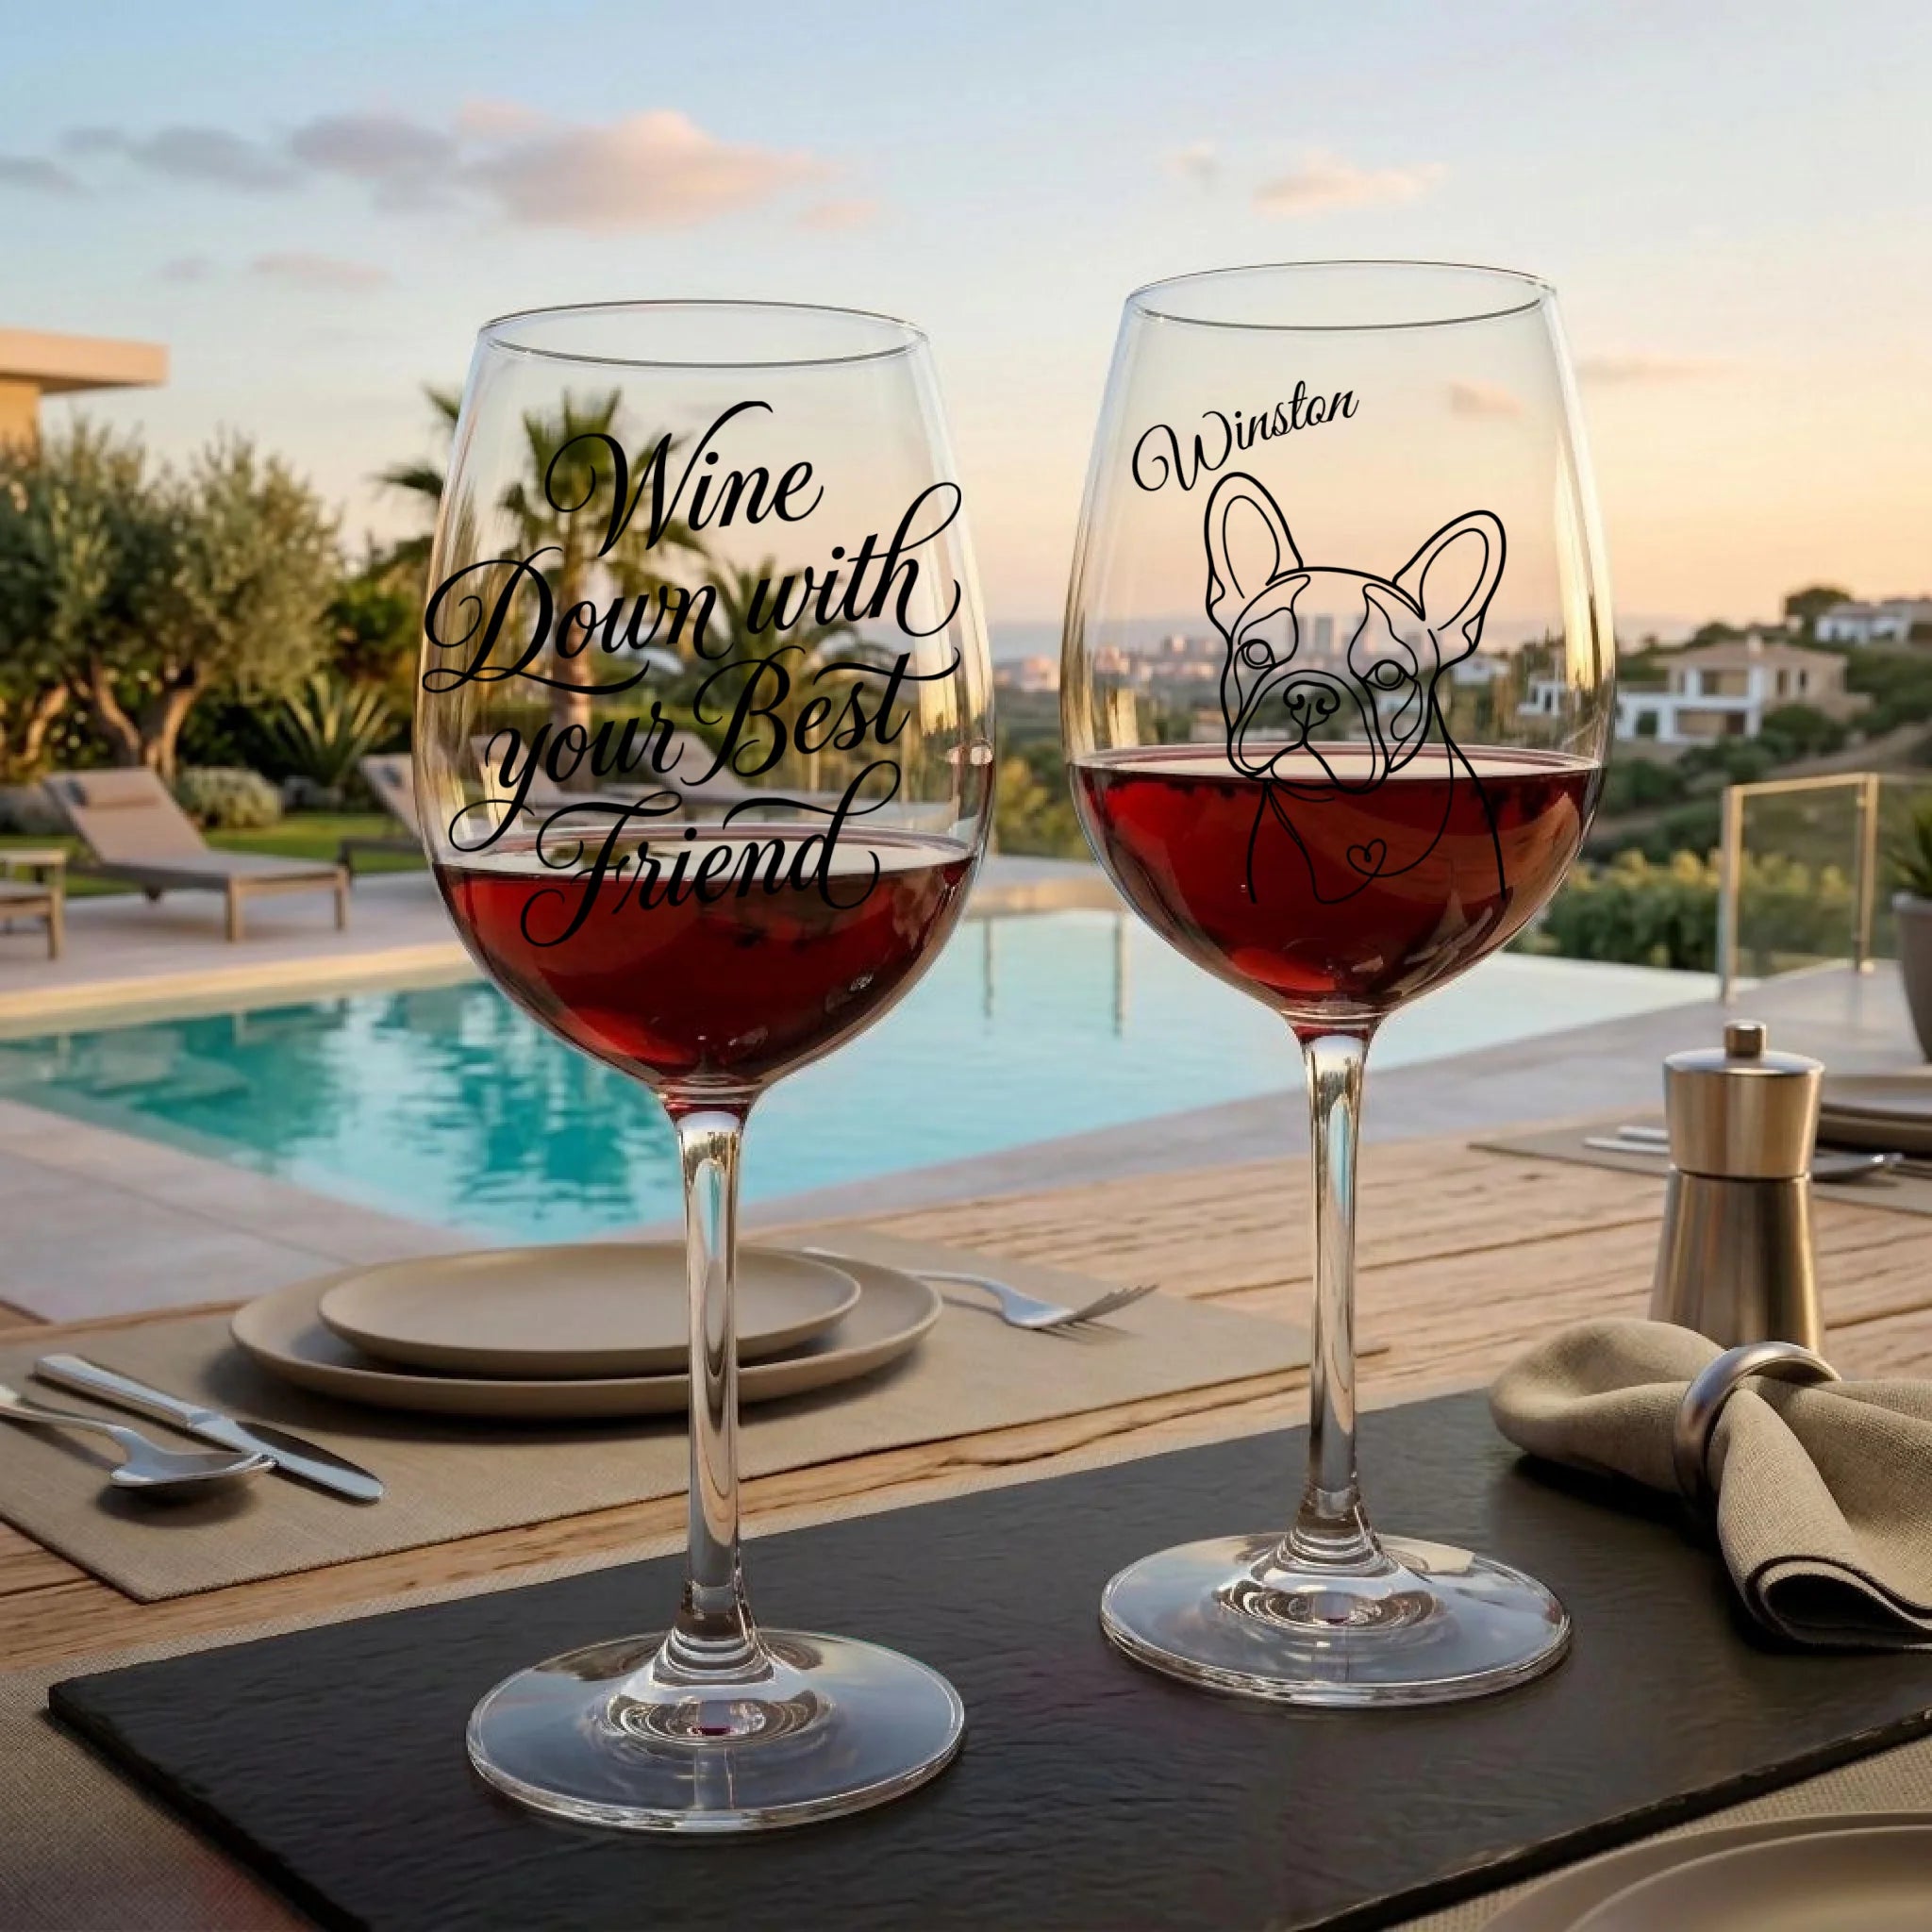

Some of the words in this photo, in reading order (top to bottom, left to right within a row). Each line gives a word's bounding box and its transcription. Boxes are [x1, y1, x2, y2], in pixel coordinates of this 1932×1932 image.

[544, 400, 824, 558] Wine
[1132, 380, 1359, 491] Winston
[422, 547, 734, 694] Down
[746, 481, 962, 637] with
[448, 701, 685, 852] your
[680, 645, 961, 786] Best
[520, 759, 901, 947] Friend
